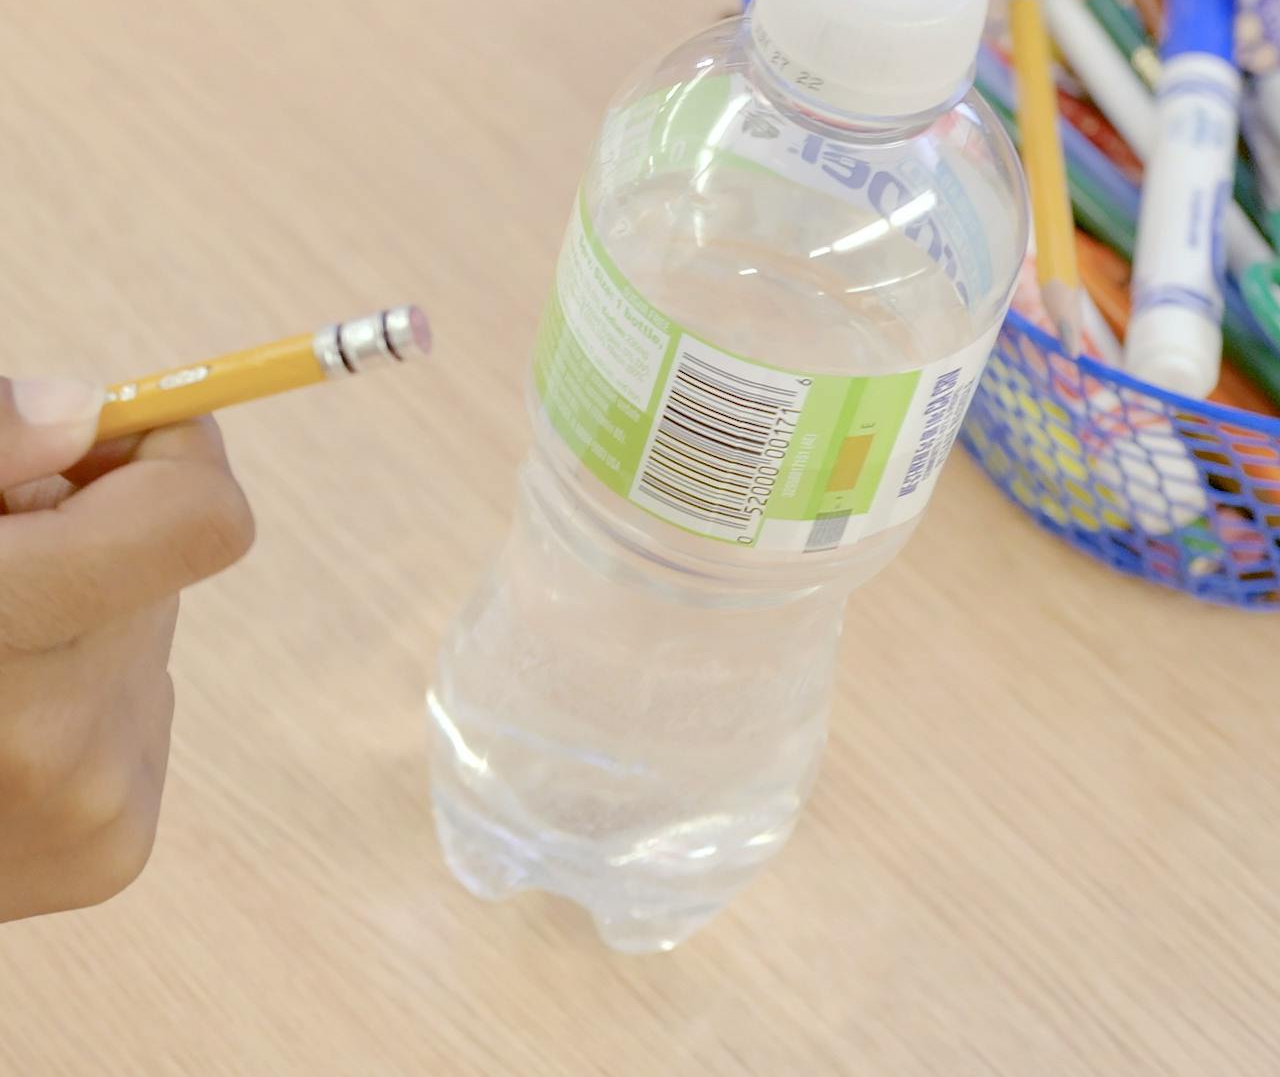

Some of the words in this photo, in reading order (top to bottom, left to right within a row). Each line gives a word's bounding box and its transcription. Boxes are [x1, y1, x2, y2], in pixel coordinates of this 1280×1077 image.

[795, 71, 824, 91] 22
[623, 306, 663, 349] bottle,
[797, 377, 812, 387] 6
[764, 408, 801, 460] 00171
[744, 466, 780, 516] 52000
[737, 534, 754, 546] 0
